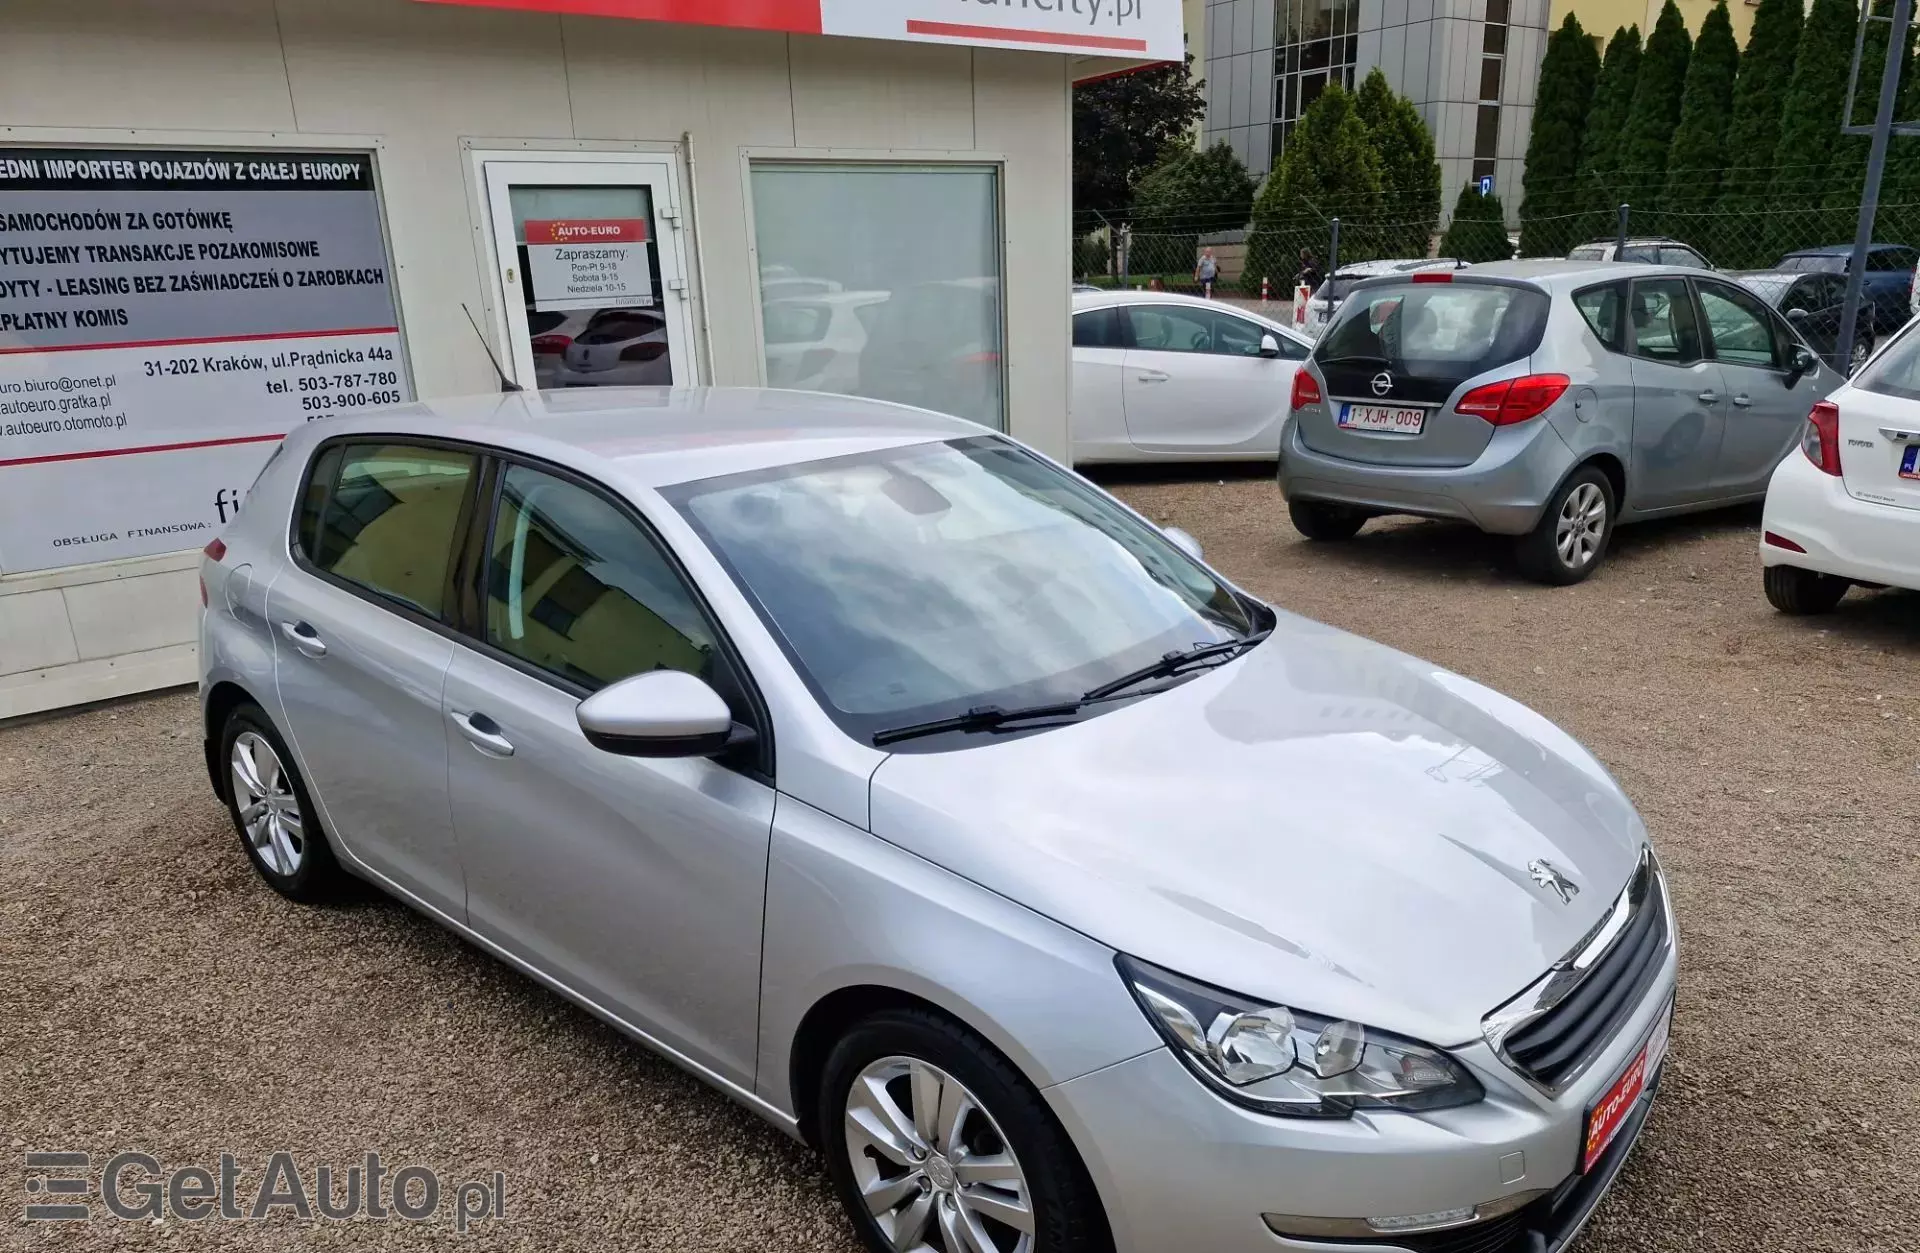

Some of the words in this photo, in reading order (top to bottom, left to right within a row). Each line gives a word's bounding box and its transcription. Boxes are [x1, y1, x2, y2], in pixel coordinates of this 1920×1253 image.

[43, 159, 137, 180] IMPORTER
[139, 158, 230, 180] POJAZDÓW
[234, 162, 246, 181] Z
[250, 162, 298, 181] CAŁEJ
[301, 163, 360, 181] EUROPY
[126, 212, 150, 231] ZA
[153, 208, 233, 232] GOTÓWKĘ
[558, 227, 621, 235] AUTO-EURO
[84, 243, 196, 263] TRANSAKCJE
[198, 240, 320, 260] POZAKOMISOWE
[555, 248, 629, 262] Zapraszamy:
[599, 262, 617, 271] 9-18
[55, 276, 131, 297] LEASING
[133, 275, 167, 294] BEZ
[170, 269, 279, 291] ZAŚWIADCZEŃ
[282, 270, 294, 288] O
[296, 267, 384, 287] ZAROBKACH
[567, 285, 603, 293] Niedziela
[605, 282, 626, 292] 10-15
[572, 274, 600, 283] Sobota
[73, 308, 129, 328] KOMIS
[143, 358, 199, 377] 31-202
[202, 354, 268, 373] Kraków,
[271, 349, 364, 369] ul.Prądnicka
[367, 346, 393, 361] 44a
[266, 379, 294, 394] tel.
[298, 371, 397, 392] 503-787-780
[302, 390, 400, 411] 503-900-605
[53, 532, 118, 547] OBSŁUGA
[127, 521, 213, 538] FINANSOWA:
